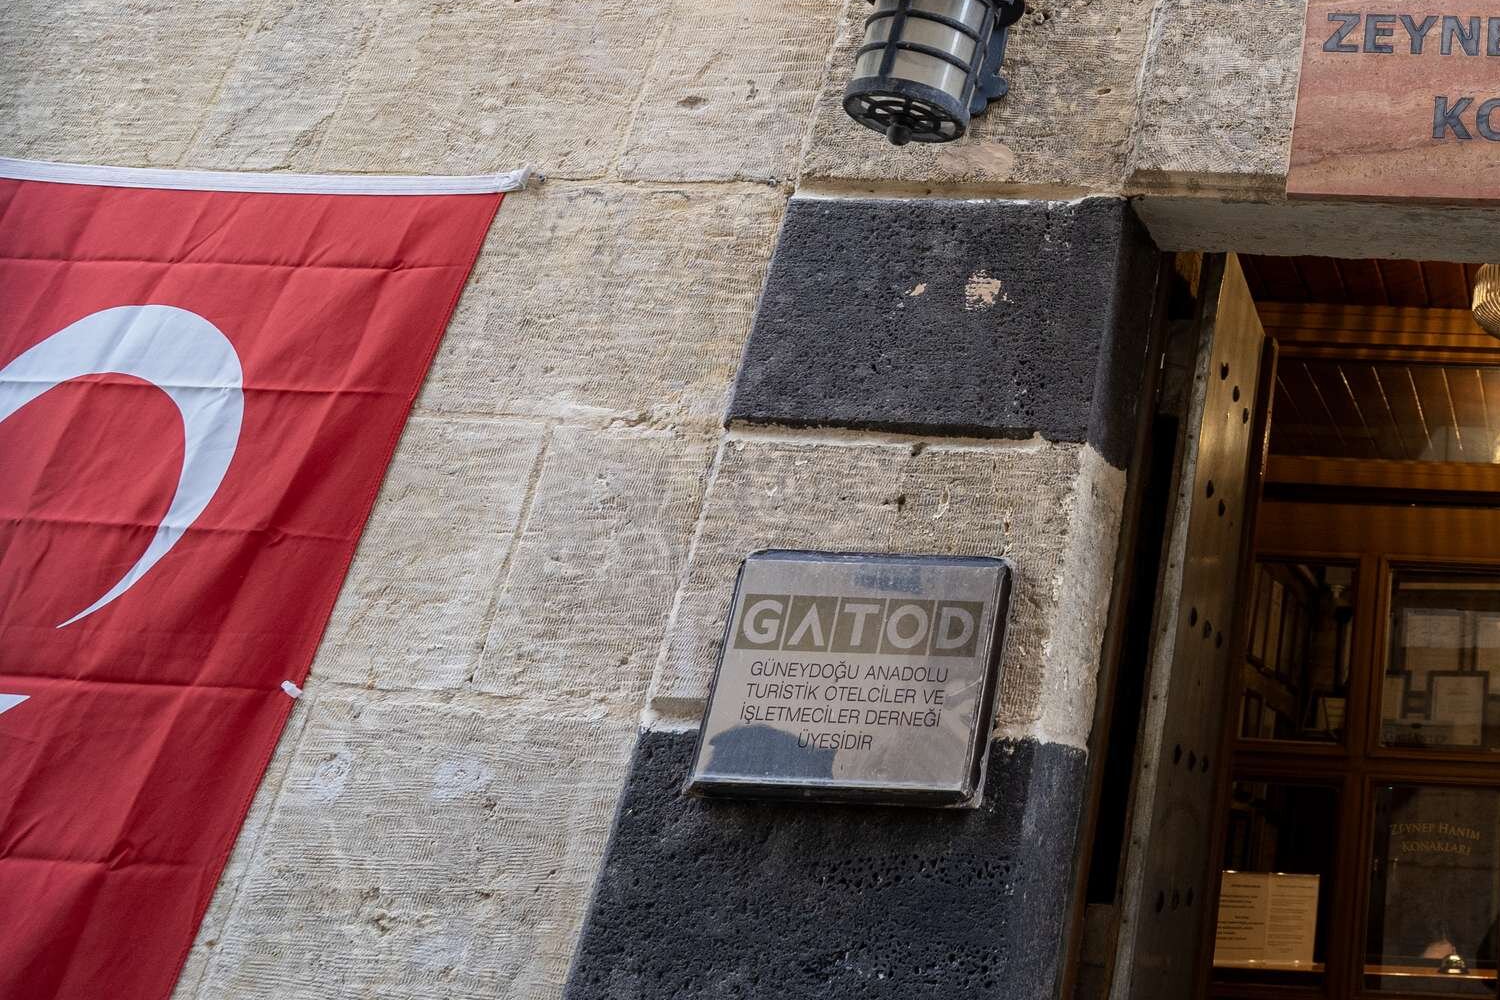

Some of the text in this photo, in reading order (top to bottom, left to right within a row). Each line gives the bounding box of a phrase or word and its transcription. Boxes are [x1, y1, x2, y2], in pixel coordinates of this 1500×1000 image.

[742, 598, 975, 650] GATOD
[749, 660, 949, 683] GÜNEYDOĞU ANADOLU
[746, 682, 946, 705] TURİSTİK OTELCİLER VE
[739, 702, 943, 728] İŞLETMECİLER DERNEĞİ
[797, 728, 873, 751] ÜYESİDİR
